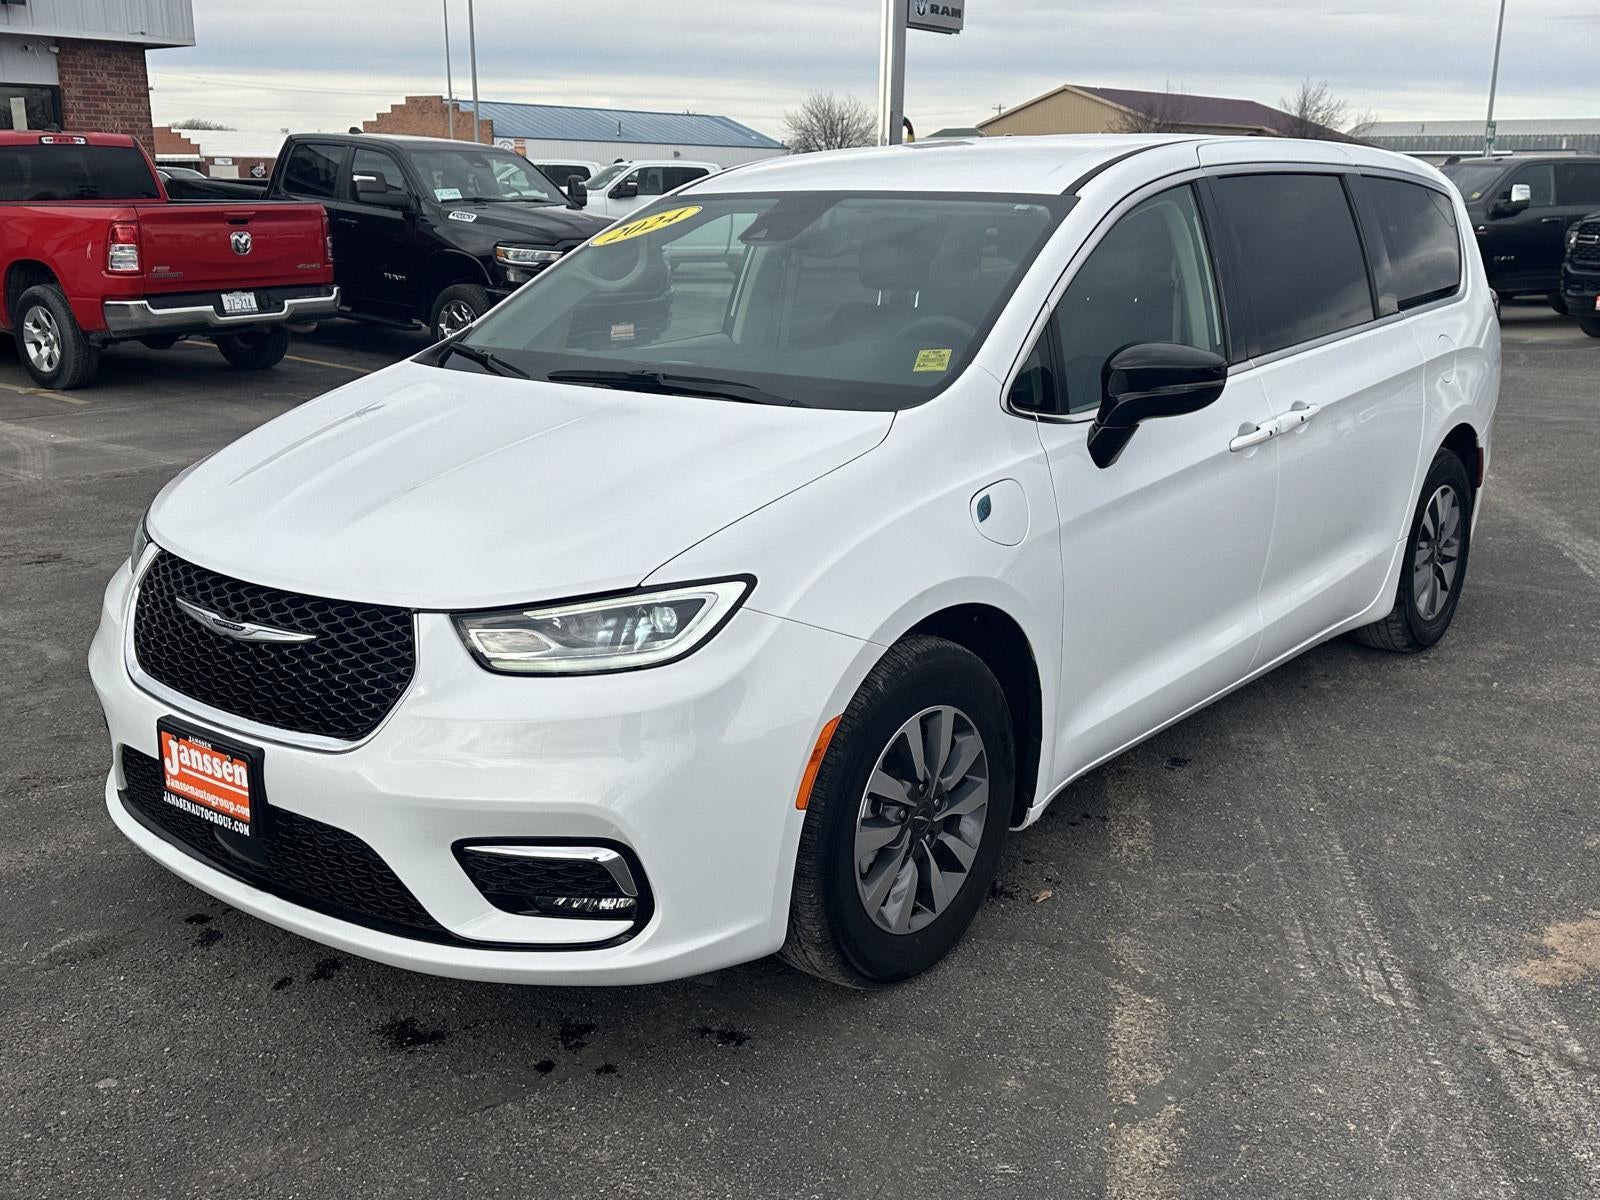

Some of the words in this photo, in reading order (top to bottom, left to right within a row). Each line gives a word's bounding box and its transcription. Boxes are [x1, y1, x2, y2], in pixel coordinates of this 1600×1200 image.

[930, 4, 961, 18] RAM
[604, 207, 689, 243] 2024
[165, 739, 249, 788] Janssen
